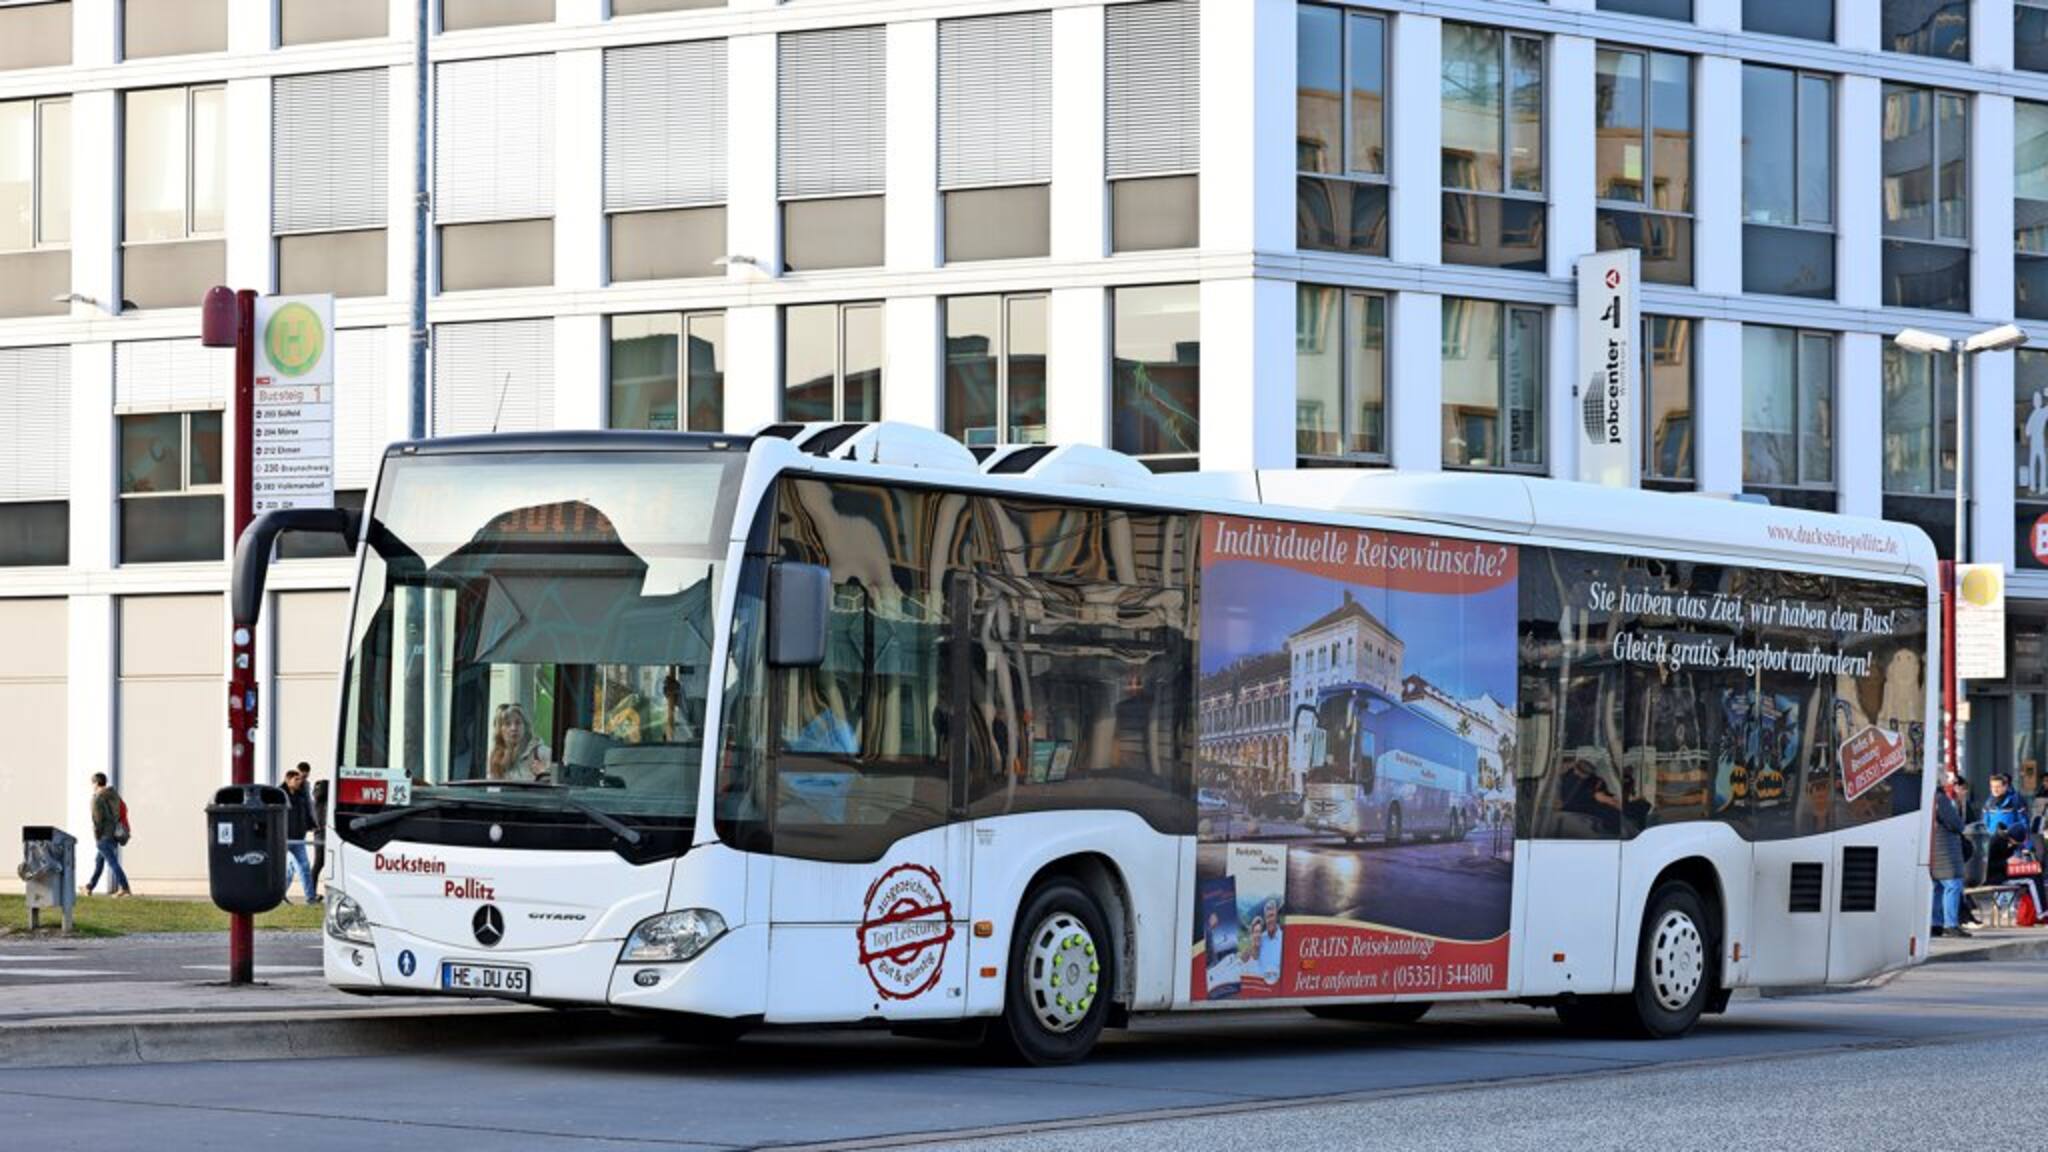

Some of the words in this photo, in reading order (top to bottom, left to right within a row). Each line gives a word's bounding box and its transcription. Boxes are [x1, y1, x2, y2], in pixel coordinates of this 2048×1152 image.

[313, 385, 320, 403] 1
[1606, 338, 1621, 443] jobcenter
[1214, 520, 1349, 565] Individuelle
[1353, 532, 1507, 577] Reisewünsche?
[1587, 581, 1616, 612] Sie
[1618, 584, 1674, 617] haben
[1675, 589, 1707, 620] das
[1709, 592, 1745, 630] Ziel,
[1750, 596, 1777, 626] wir
[1778, 599, 1827, 630] haben
[1829, 604, 1858, 632] den
[1860, 606, 1896, 635] Bus!
[1612, 631, 1667, 663] Gleich
[1669, 637, 1721, 672] gratis
[1722, 639, 1788, 677] Angebot
[1790, 645, 1873, 680] anfordern!
[361, 785, 386, 801] WVG
[374, 853, 447, 875] Duckstein
[445, 878, 496, 901] Pollitz
[527, 912, 587, 921] CITARO
[872, 931, 893, 947] Top
[894, 921, 941, 940] Leistung
[1299, 936, 1348, 958] GRATIS
[1350, 936, 1436, 961] Reisekataloge
[452, 967, 471, 987] HE
[482, 970, 501, 988] DU
[505, 971, 524, 990] 65
[1295, 971, 1321, 992] Jetzt
[1321, 970, 1377, 993] anfordern
[1392, 964, 1443, 989] (05351)
[1446, 963, 1494, 985] 544800
